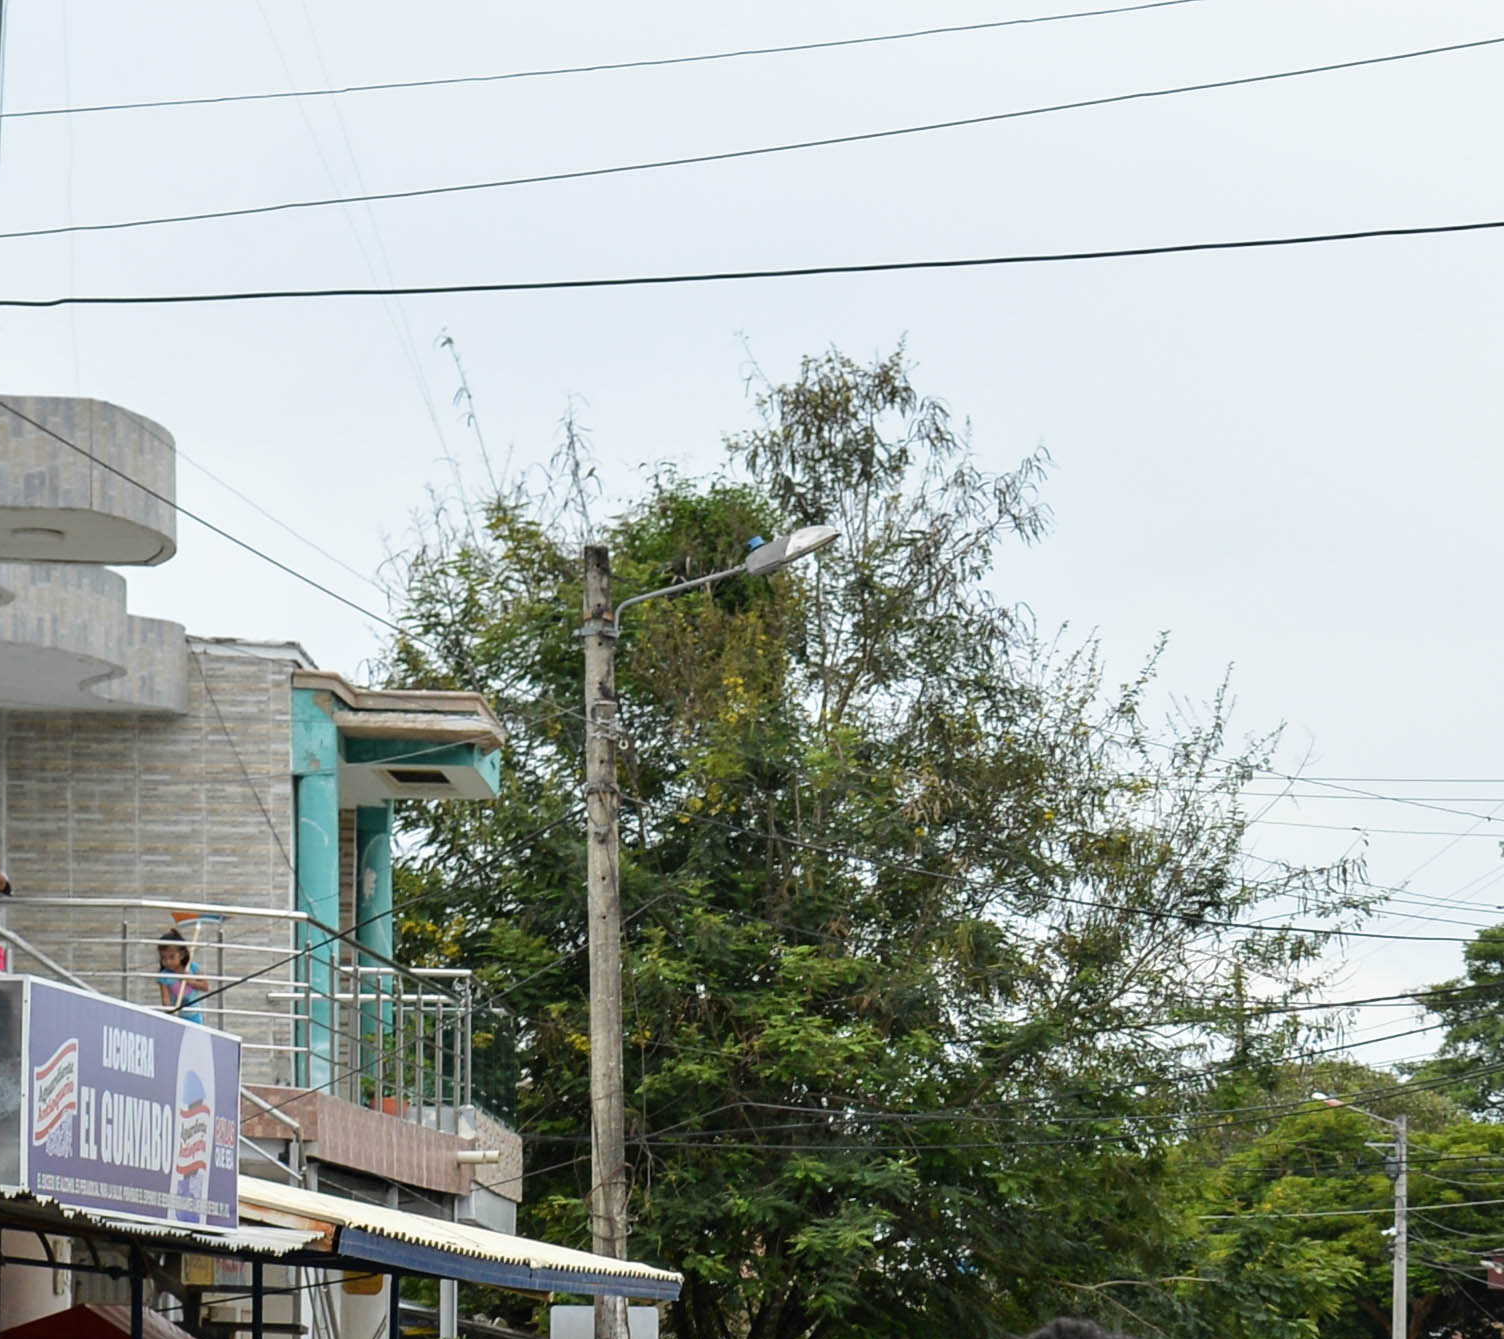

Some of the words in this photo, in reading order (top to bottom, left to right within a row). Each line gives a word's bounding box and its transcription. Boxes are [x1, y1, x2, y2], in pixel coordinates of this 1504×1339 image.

[103, 1025, 155, 1079] LICORERA
[80, 1086, 98, 1161] EL
[101, 1090, 173, 1175] GUAYABO
